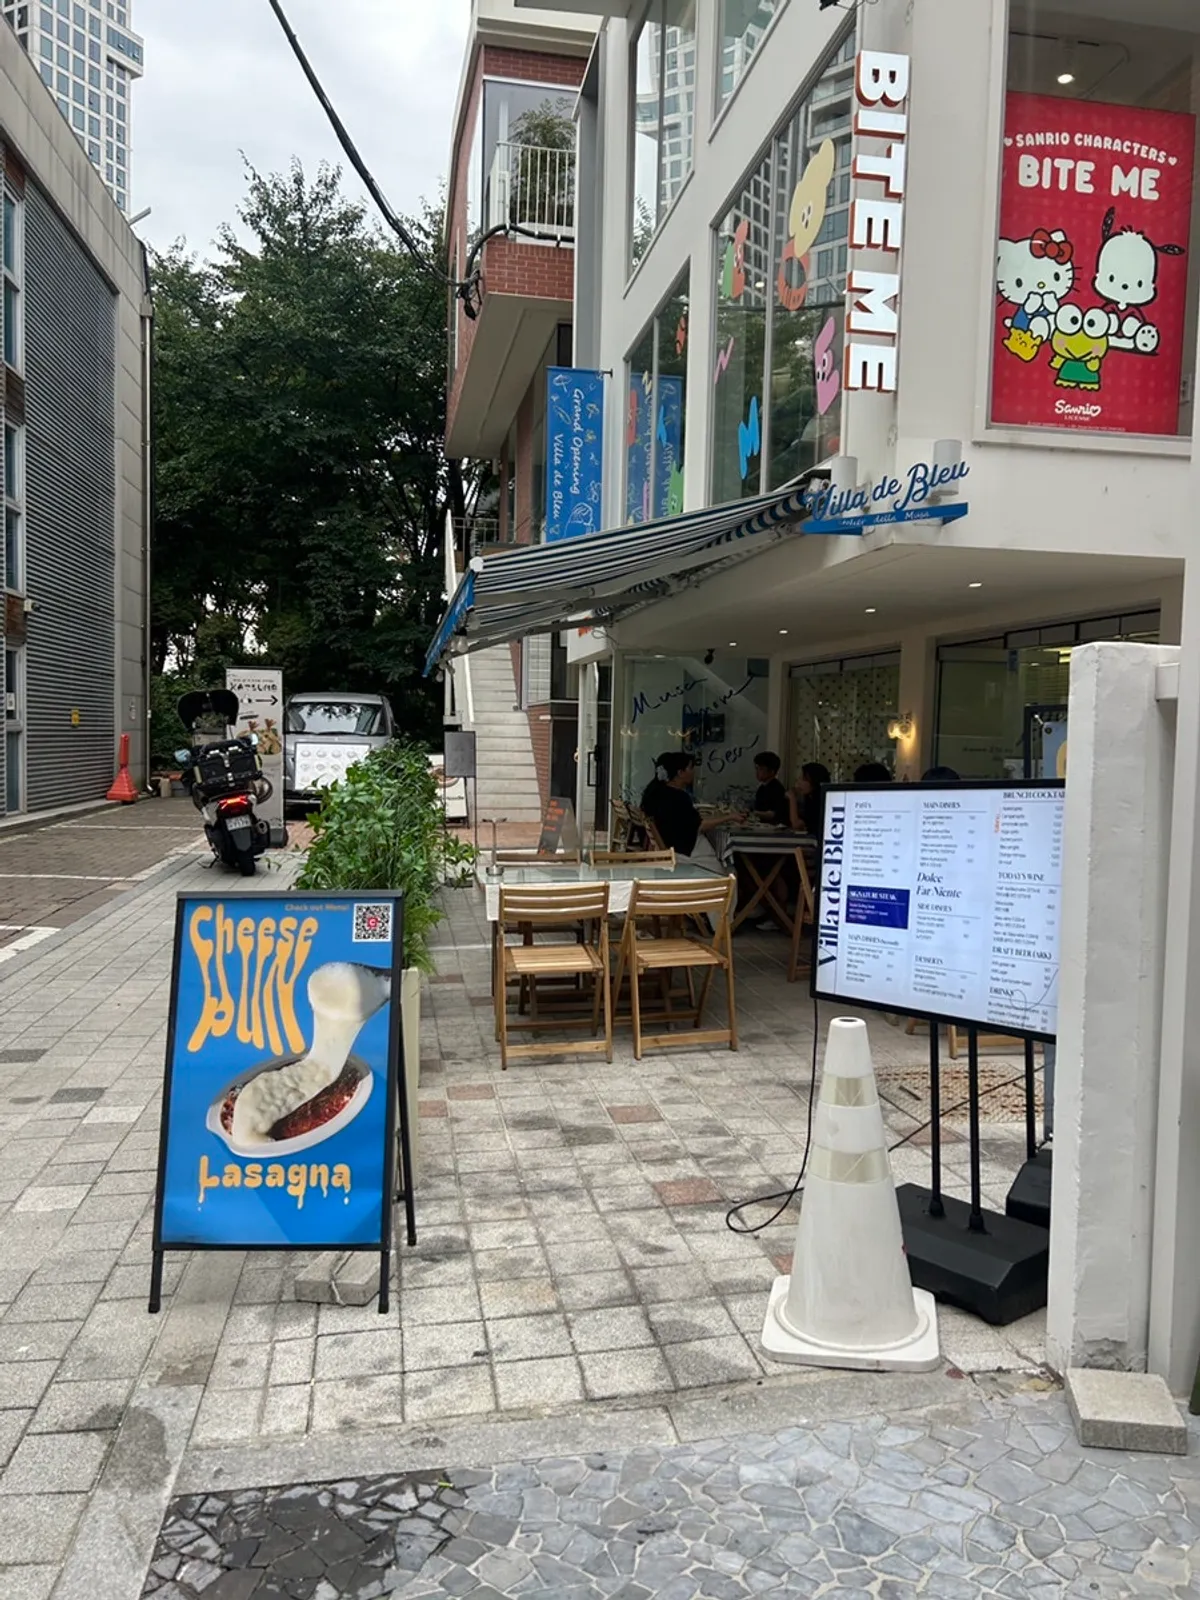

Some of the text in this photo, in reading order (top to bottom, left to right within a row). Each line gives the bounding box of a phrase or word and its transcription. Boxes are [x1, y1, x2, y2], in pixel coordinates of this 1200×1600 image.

[1015, 132, 1167, 164] SANRIO CHARACTERS
[1018, 154, 1161, 200] BITE ME
[844, 50, 910, 393] BITE ME
[1054, 399, 1101, 417] Sanrio
[570, 388, 584, 495] Grand Opening
[552, 433, 564, 519] Villa de Bleu
[797, 461, 970, 521] Villa de Bleu
[818, 806, 846, 967] Villa de Bleu
[916, 885, 962, 898] Far Niente
[917, 872, 943, 883] Dolce
[189, 903, 319, 968] Cheese
[197, 1154, 352, 1212] Lasagna
